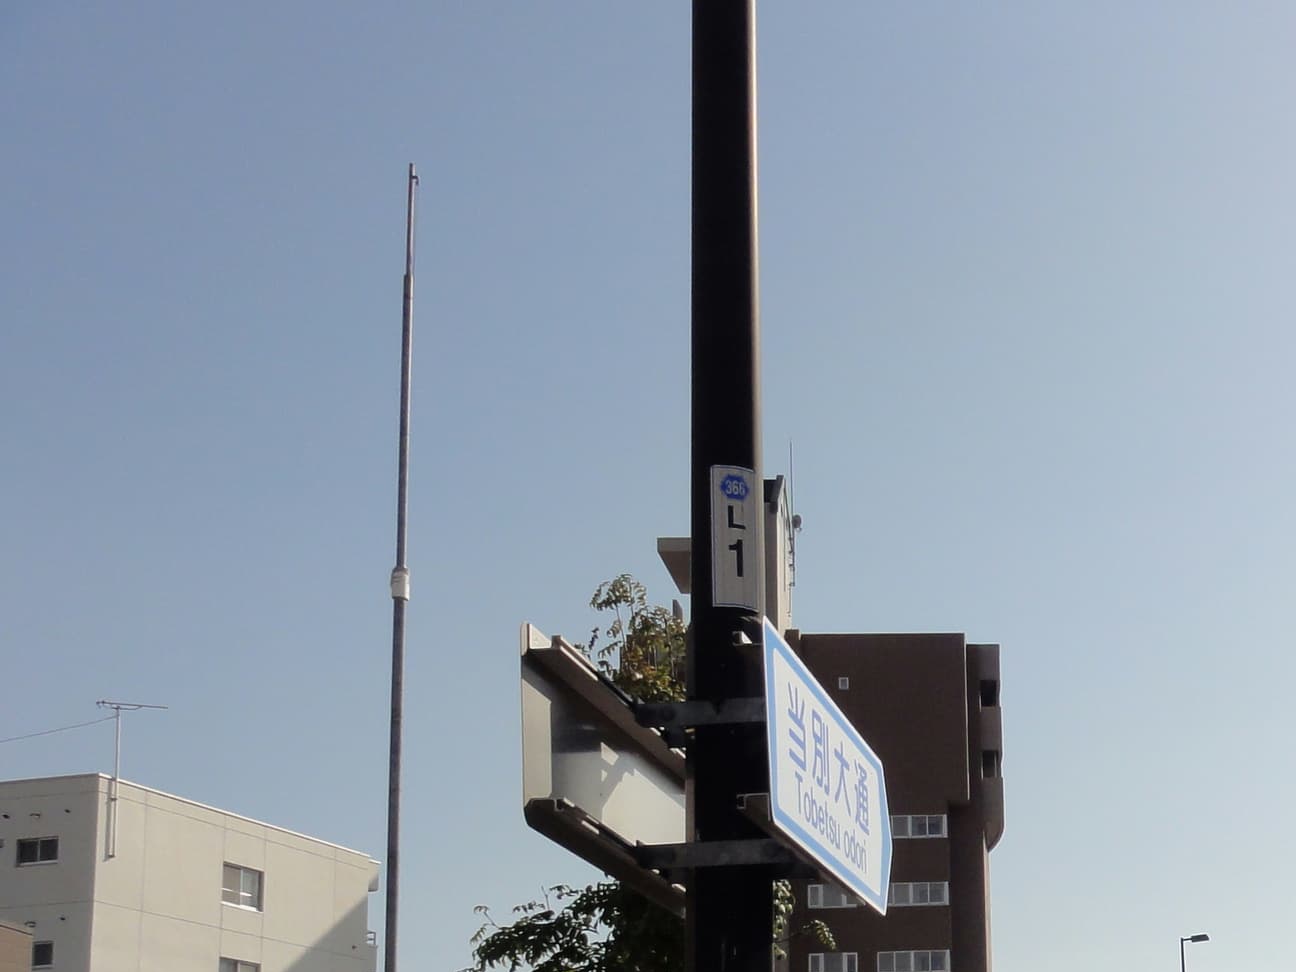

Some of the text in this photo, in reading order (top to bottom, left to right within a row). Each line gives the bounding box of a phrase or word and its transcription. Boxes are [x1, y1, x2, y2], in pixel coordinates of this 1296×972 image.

[725, 480, 746, 496] 366
[727, 505, 746, 529] L
[728, 539, 744, 577] 1
[788, 681, 870, 836] 当別大通
[795, 771, 868, 874] Tobetsu odori
